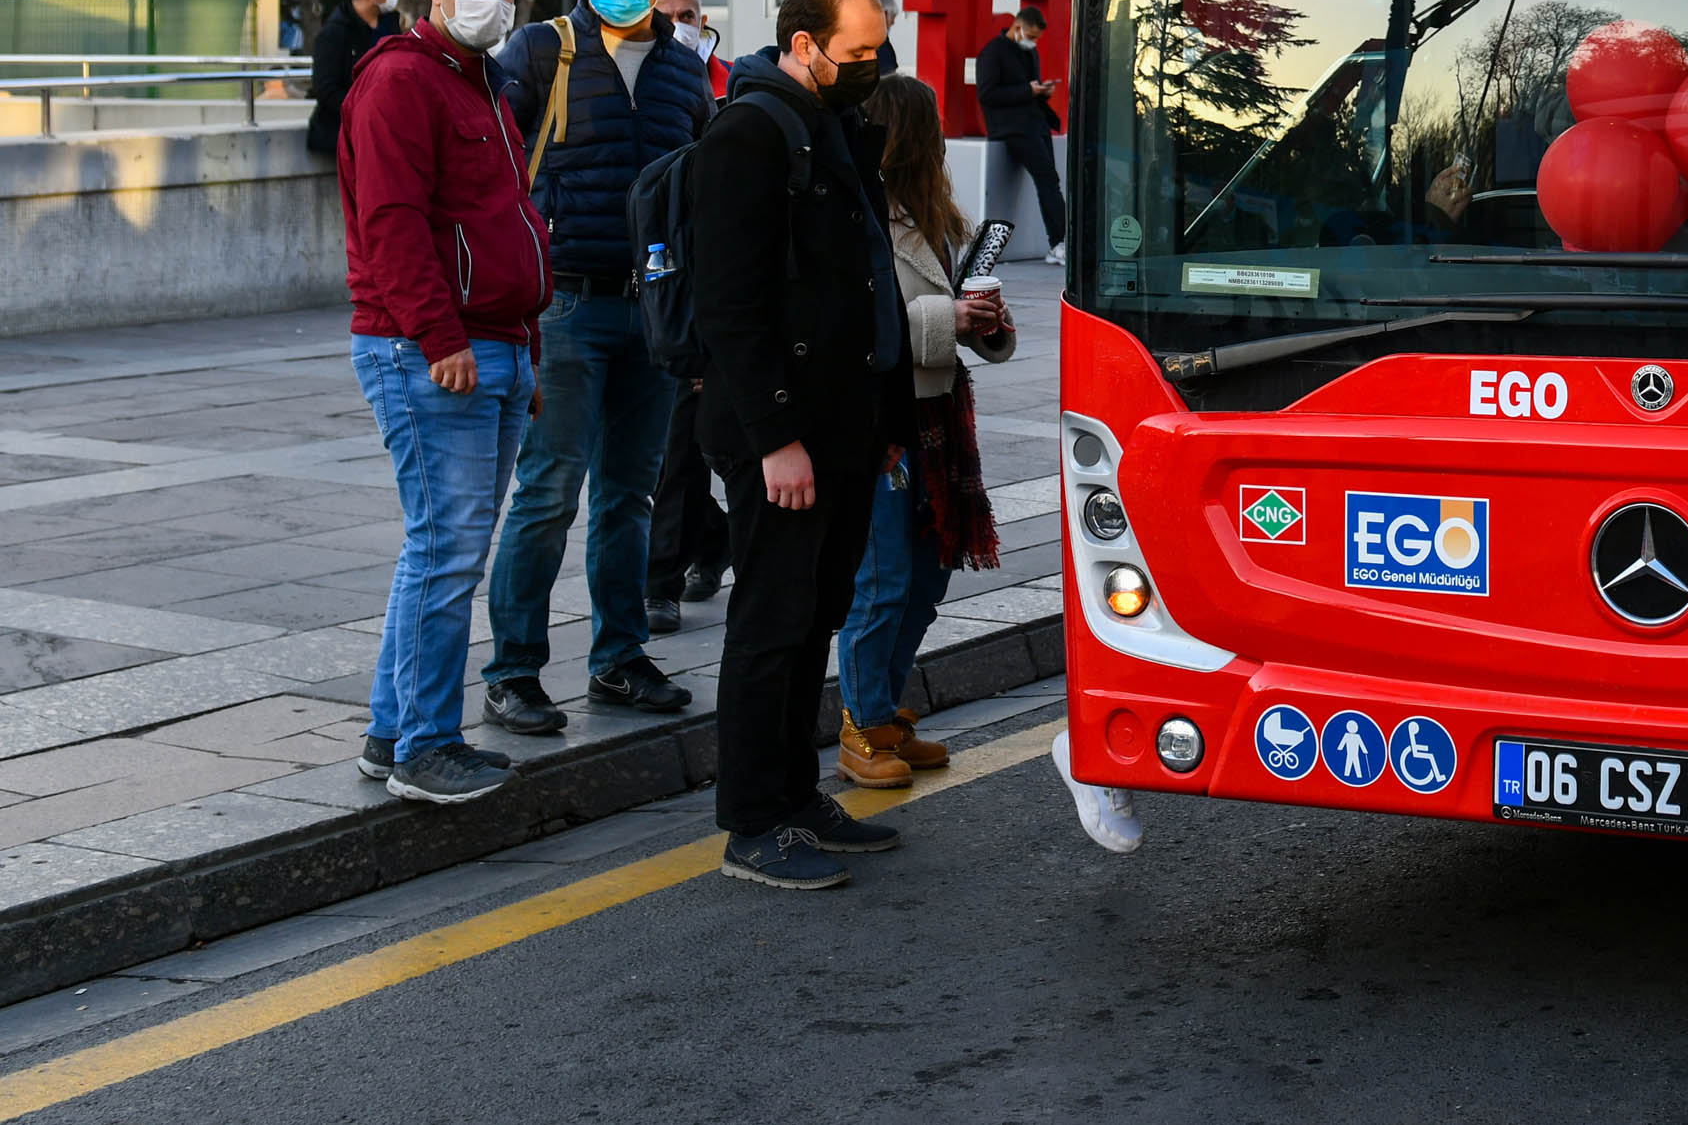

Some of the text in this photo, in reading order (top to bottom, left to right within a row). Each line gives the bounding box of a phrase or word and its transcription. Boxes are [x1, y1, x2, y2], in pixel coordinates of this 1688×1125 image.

[1469, 370, 1569, 420] EGO
[1252, 504, 1292, 525] CNG
[1353, 511, 1480, 569] EGO
[1353, 567, 1481, 590] EGO Genel Müdürlüğü
[1503, 779, 1521, 795] TR
[1526, 750, 1578, 806] 06
[1600, 757, 1681, 815] CSZ
[1512, 809, 1562, 823] Mercedes-Benz
[1580, 815, 1655, 831] Mercedes-Benz
